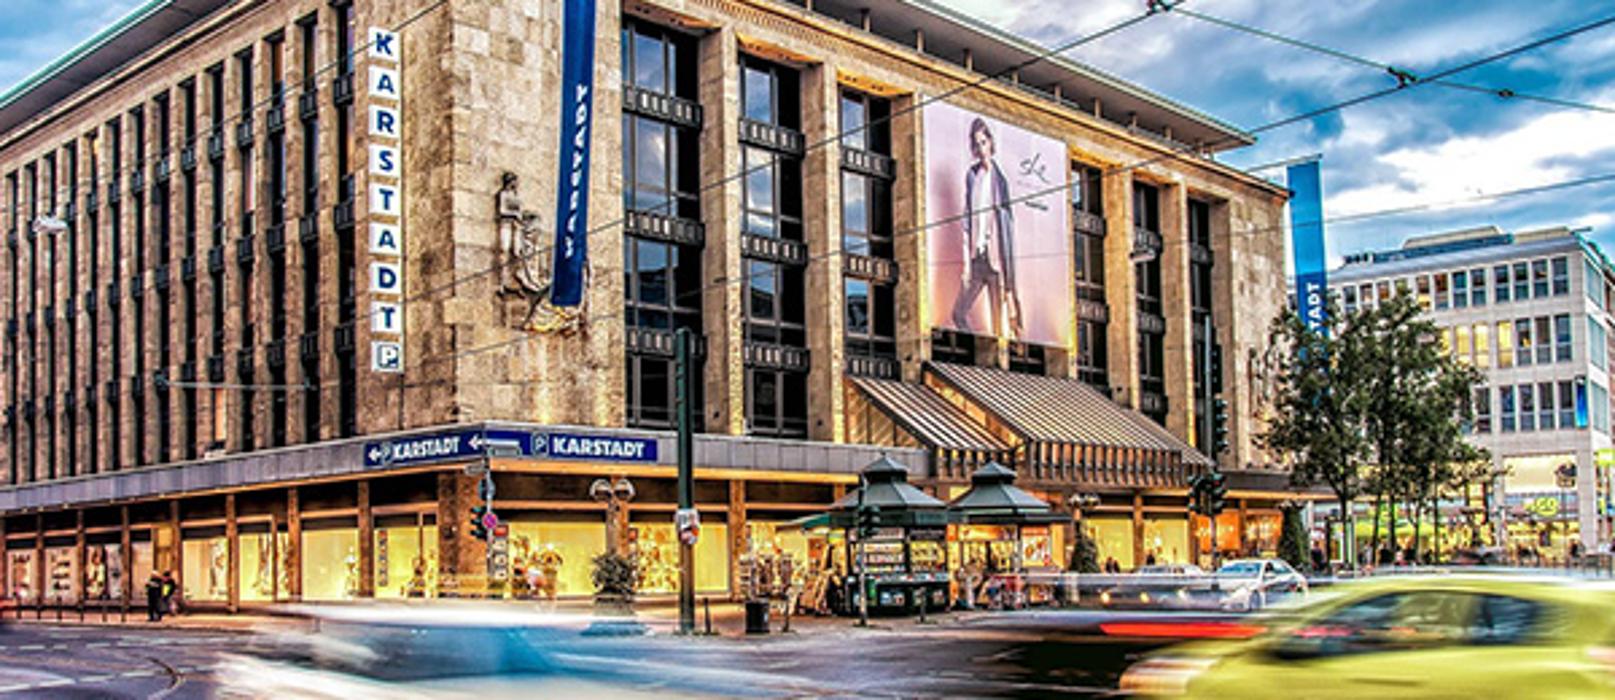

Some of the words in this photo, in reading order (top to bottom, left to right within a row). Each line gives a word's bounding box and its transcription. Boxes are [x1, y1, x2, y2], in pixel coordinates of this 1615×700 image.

[376, 31, 397, 330] KARSTADT
[392, 434, 460, 460] KARSTADT
[553, 437, 645, 459] KARSTADT
